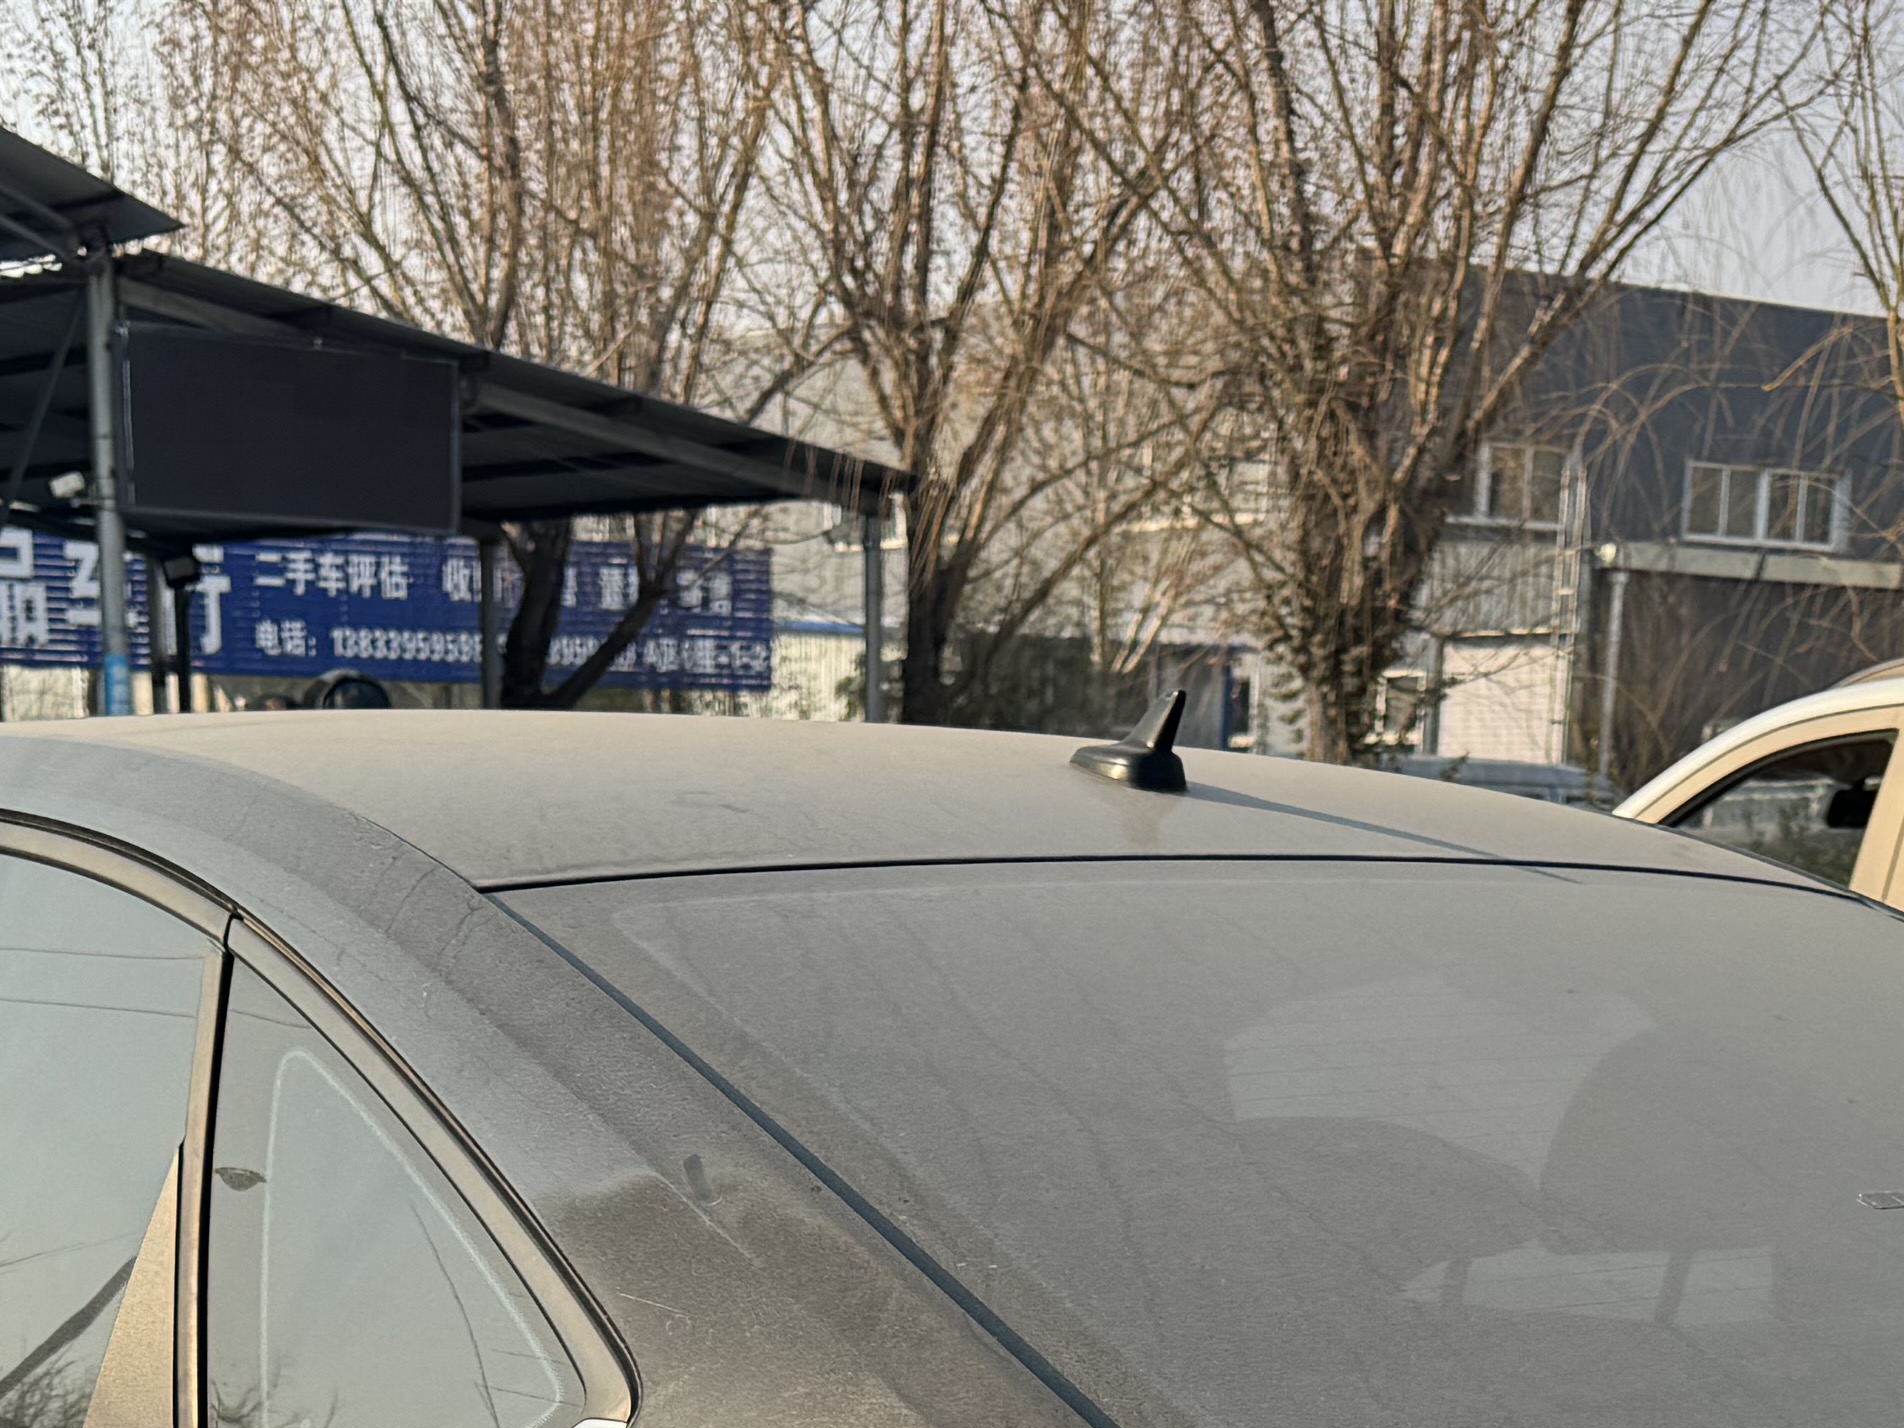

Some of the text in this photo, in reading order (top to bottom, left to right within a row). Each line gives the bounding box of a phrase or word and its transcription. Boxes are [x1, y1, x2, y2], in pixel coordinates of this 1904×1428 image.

[255, 550, 409, 600] 二手车评估
